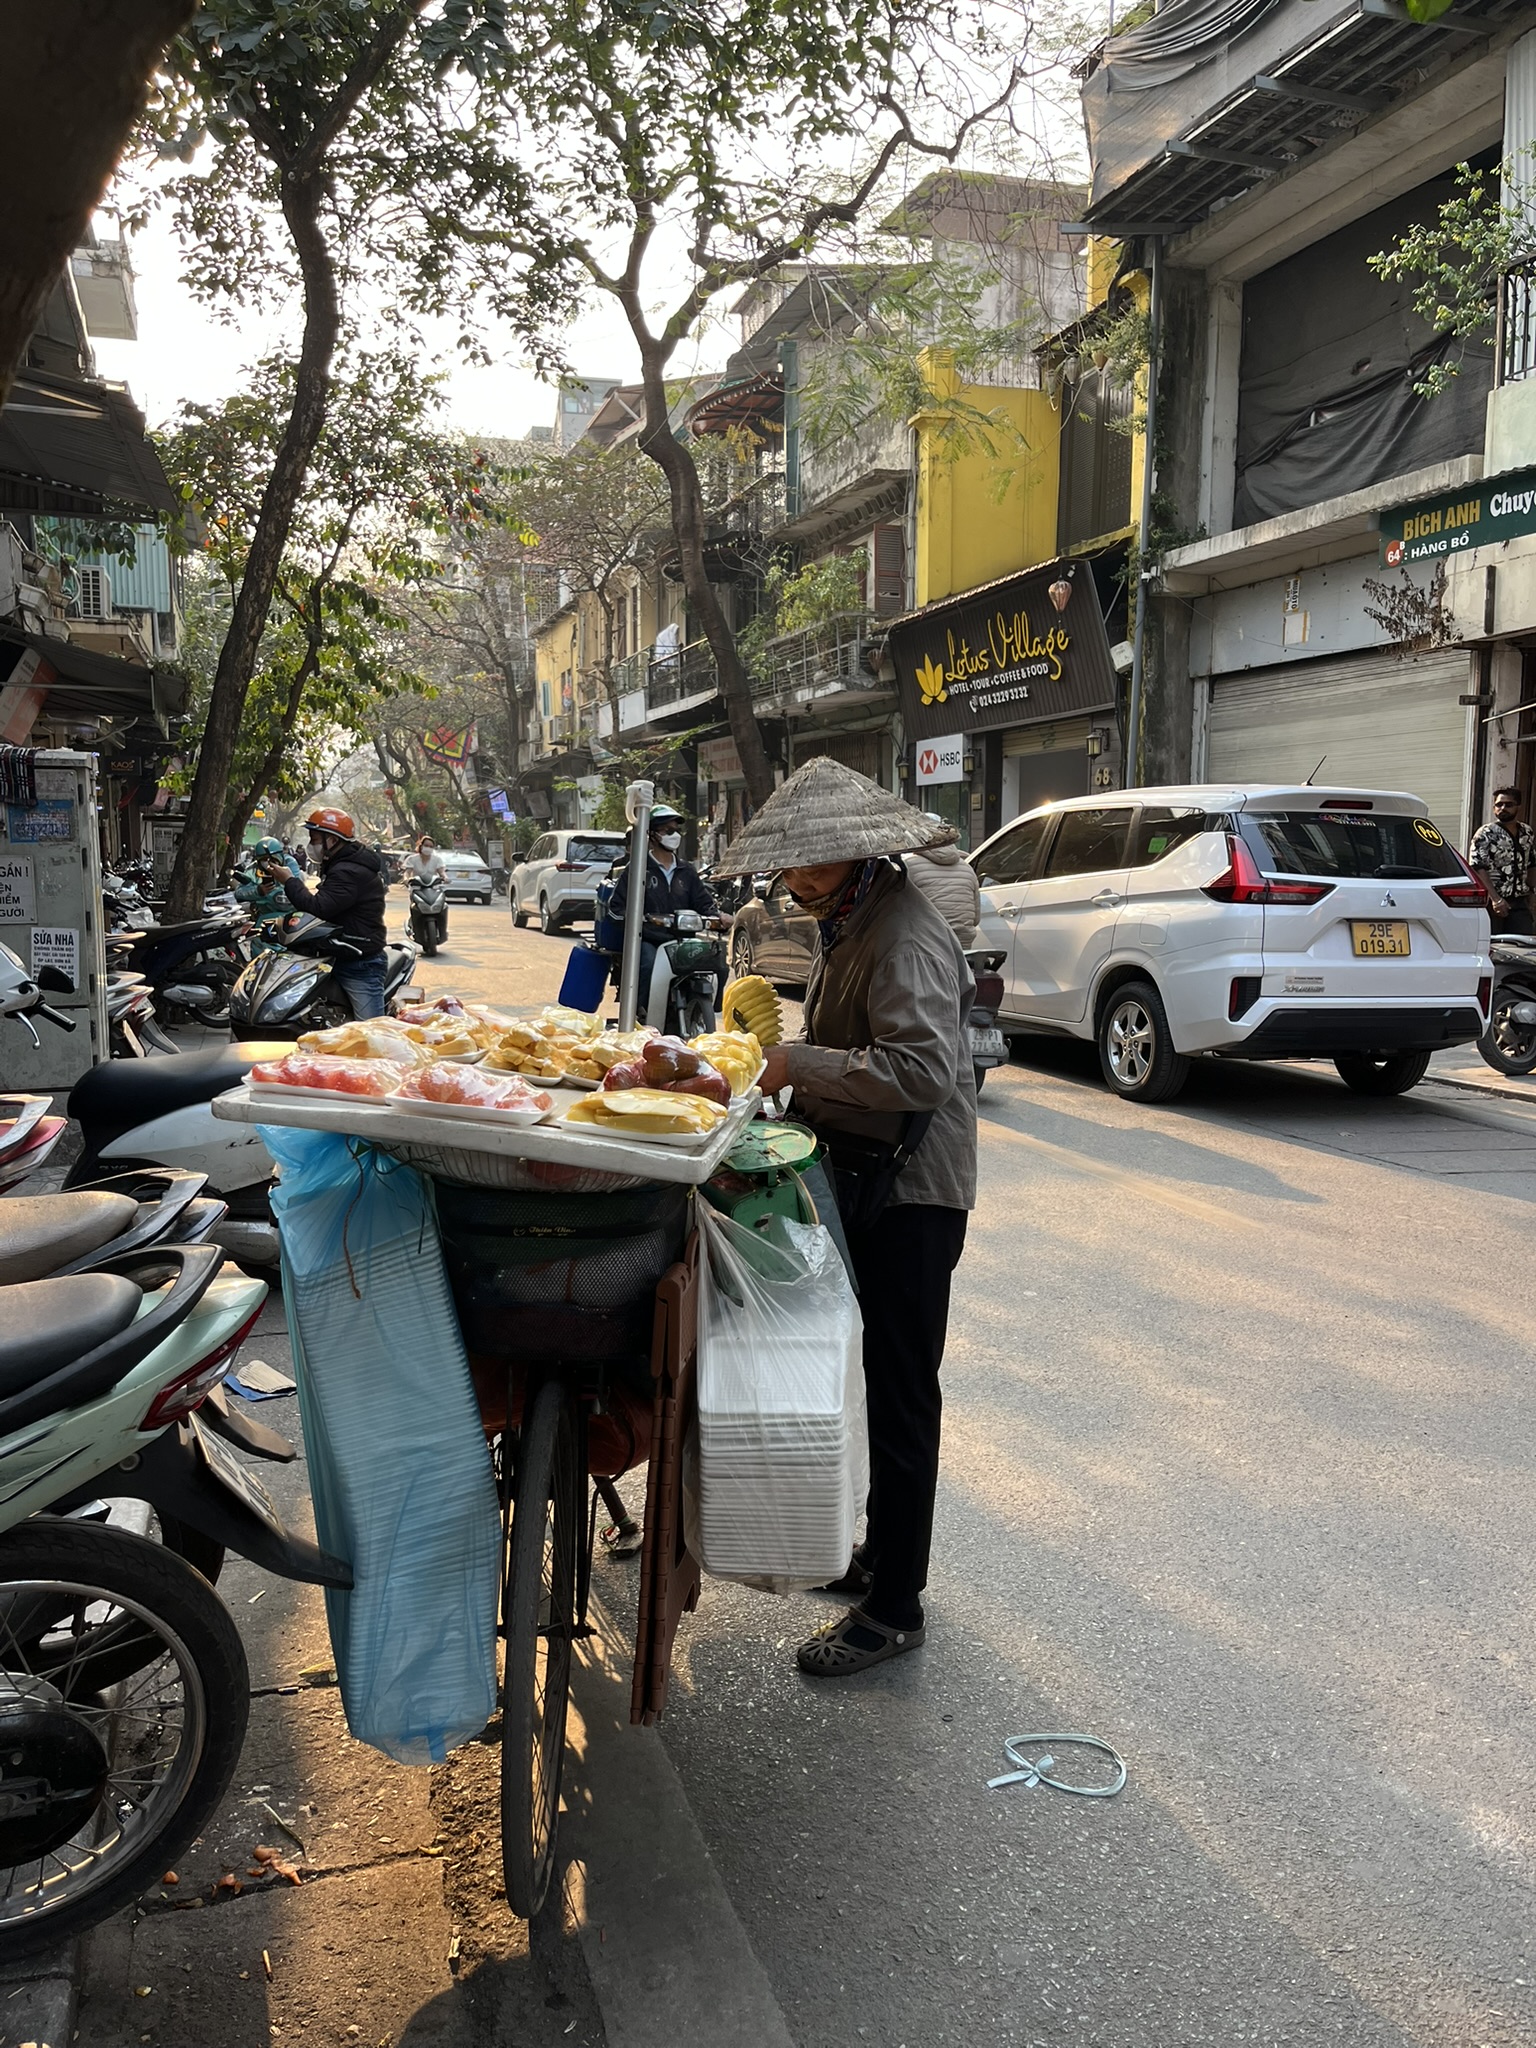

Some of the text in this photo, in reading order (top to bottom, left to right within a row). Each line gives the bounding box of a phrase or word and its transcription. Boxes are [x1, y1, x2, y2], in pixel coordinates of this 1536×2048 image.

[1403, 500, 1481, 541] BÍCH ANH
[1411, 541, 1447, 558] HÀNG
[1451, 530, 1470, 548] BỒ
[945, 611, 1069, 682] Lotus Village
[949, 681, 970, 695] HOTEL
[972, 677, 990, 691] TOUR
[940, 751, 960, 767] HSBC
[1094, 767, 1110, 785] 68
[1418, 825, 1439, 840] Pro
[0, 893, 21, 904] IỂM
[33, 929, 74, 946] SỬA NHÀ
[1369, 924, 1393, 938] 29E
[1361, 939, 1403, 953] 019.31
